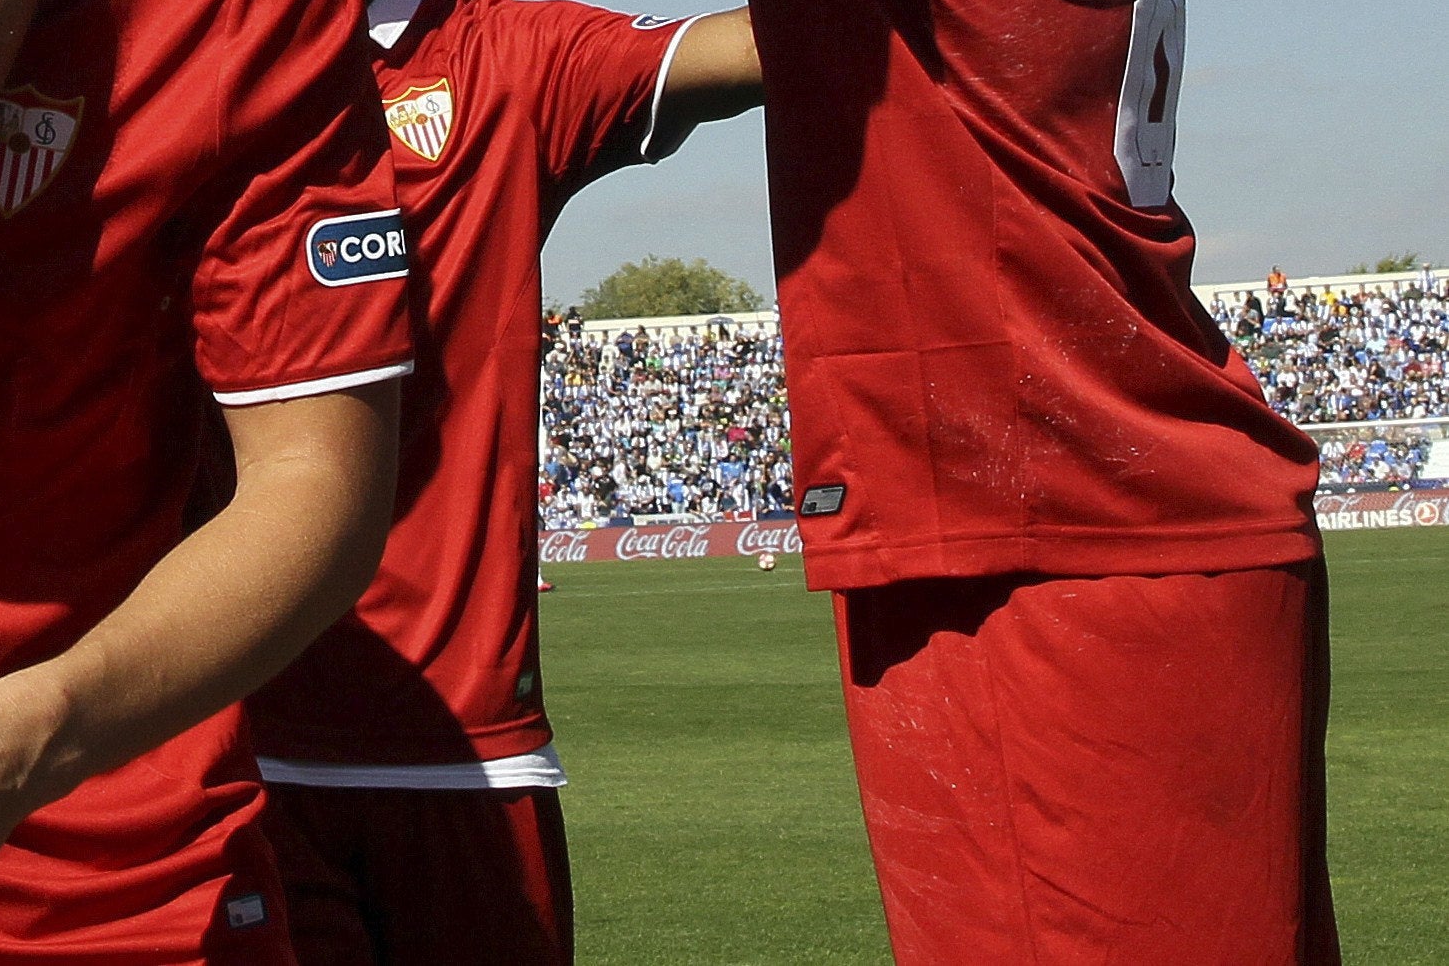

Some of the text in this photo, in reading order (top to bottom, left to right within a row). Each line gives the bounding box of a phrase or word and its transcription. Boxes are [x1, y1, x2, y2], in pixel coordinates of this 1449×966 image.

[340, 229, 406, 263] COR
[1316, 509, 1413, 530] AIRLINES
[616, 526, 710, 560] Coca-Cola
